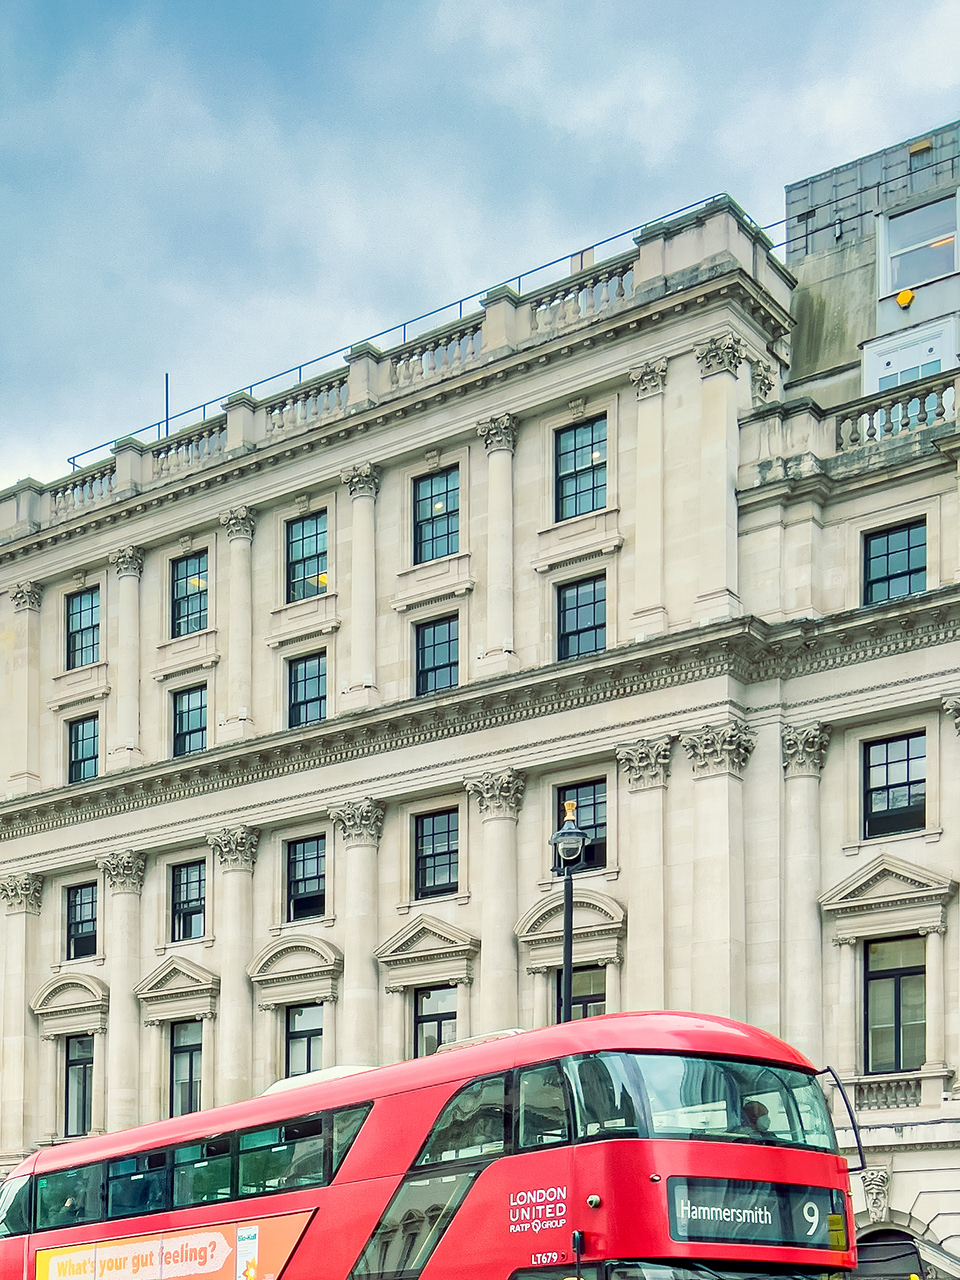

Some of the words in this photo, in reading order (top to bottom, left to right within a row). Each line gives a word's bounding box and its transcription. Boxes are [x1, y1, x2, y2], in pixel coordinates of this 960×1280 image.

[509, 1186, 567, 1206] LONDON
[509, 1203, 567, 1222] UNITED
[680, 1199, 772, 1225] Hammersmith
[803, 1201, 820, 1236] 9
[509, 1223, 531, 1233] RATP
[541, 1218, 567, 1229] GROUP
[56, 1257, 96, 1277] What's
[99, 1256, 129, 1278] your
[131, 1251, 155, 1275] gut
[158, 1240, 217, 1266] feeling?
[531, 1252, 558, 1265] LT679
